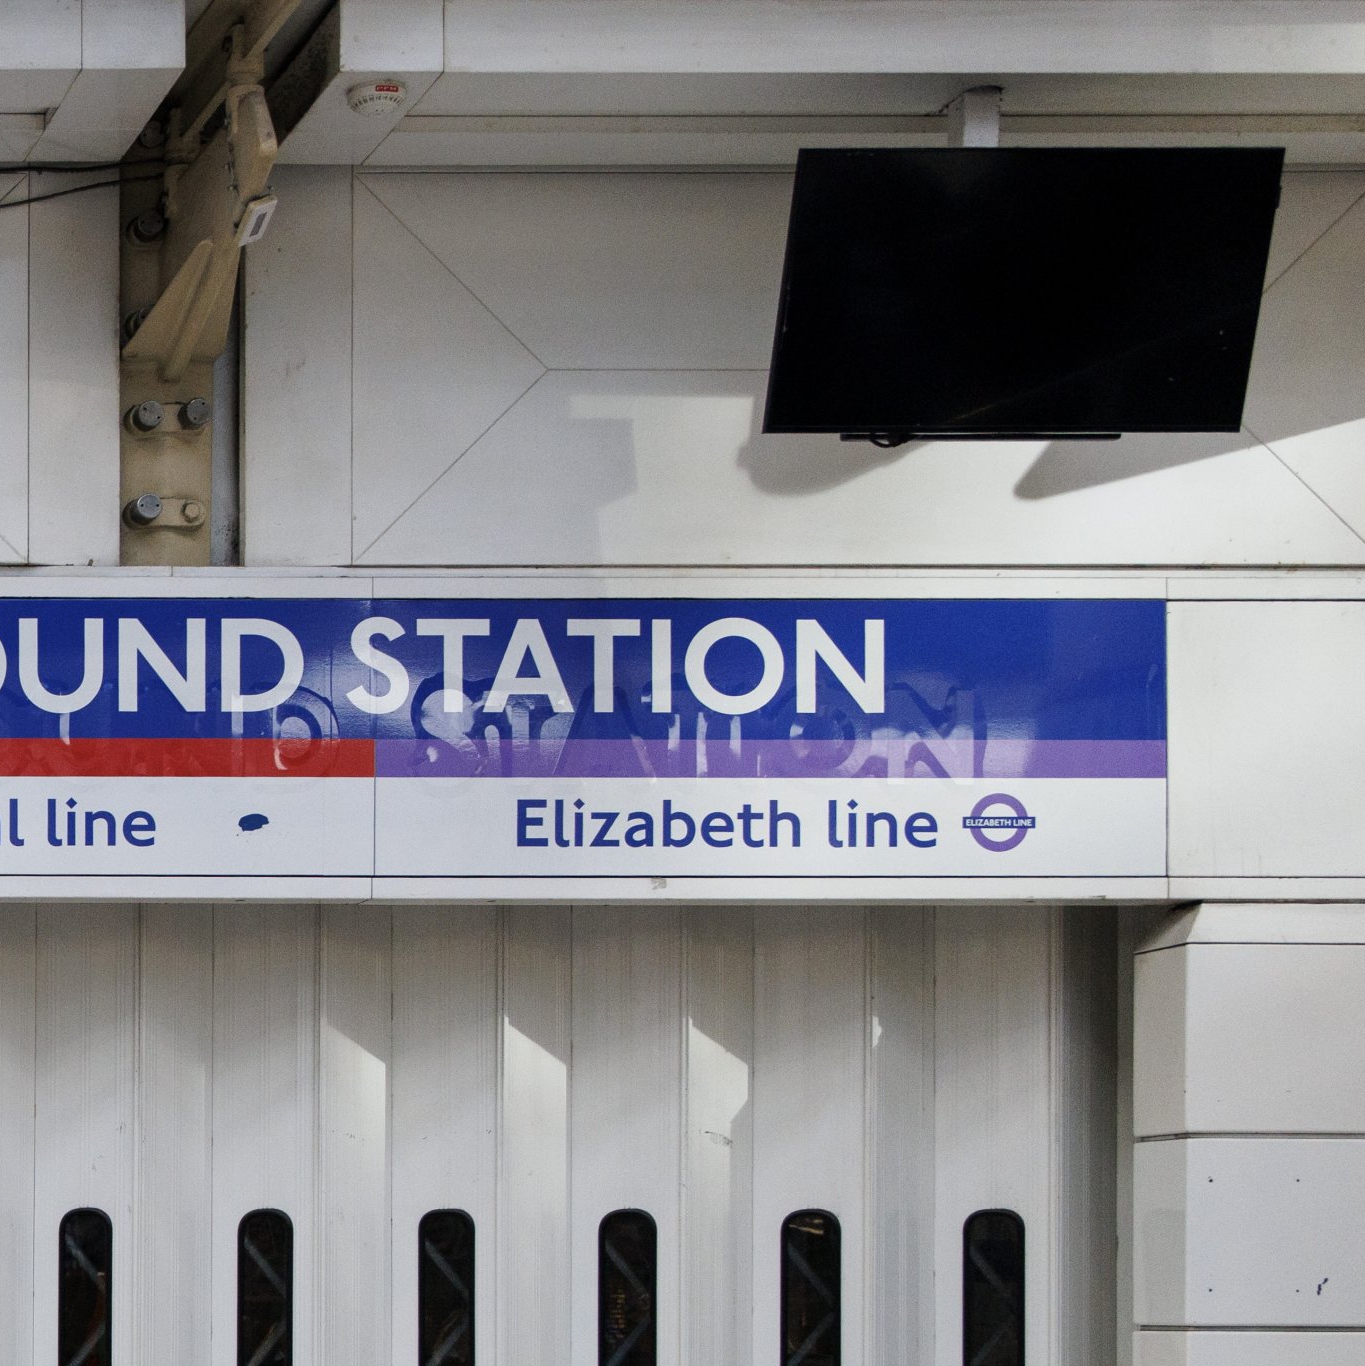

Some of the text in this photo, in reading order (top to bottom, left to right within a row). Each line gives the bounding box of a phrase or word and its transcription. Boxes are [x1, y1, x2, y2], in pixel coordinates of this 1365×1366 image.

[346, 617, 885, 714] STATION
[48, 798, 155, 846] line
[517, 799, 937, 848] Elizabeth line
